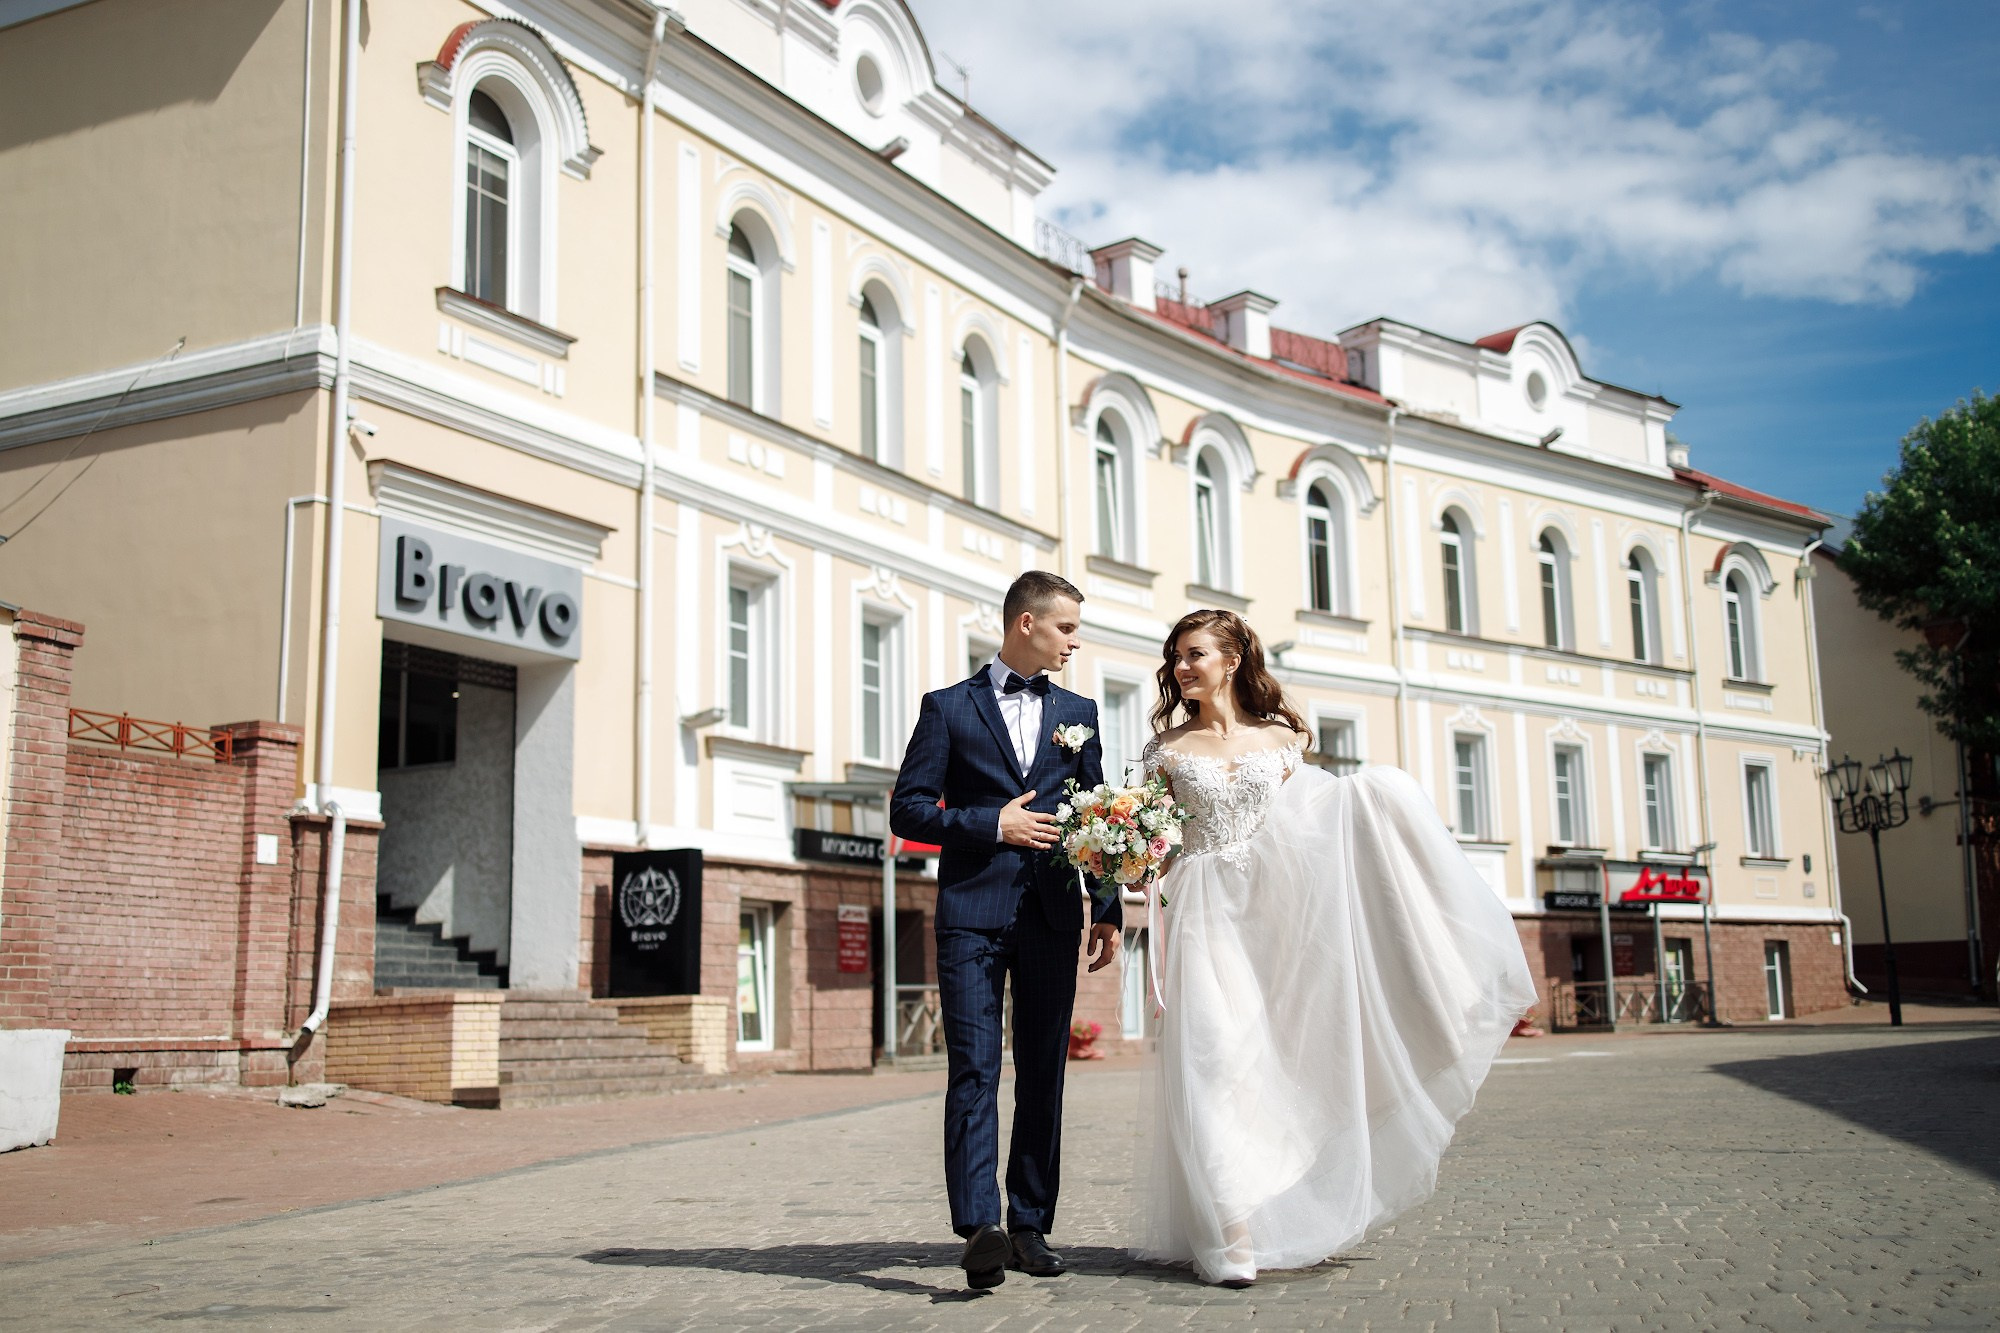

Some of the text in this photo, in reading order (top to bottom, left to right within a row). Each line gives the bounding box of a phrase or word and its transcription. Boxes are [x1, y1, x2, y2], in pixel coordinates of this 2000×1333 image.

[396, 535, 578, 642] Bravo
[822, 837, 875, 859] МУЖСКАЯ
[631, 930, 667, 942] Bravo
